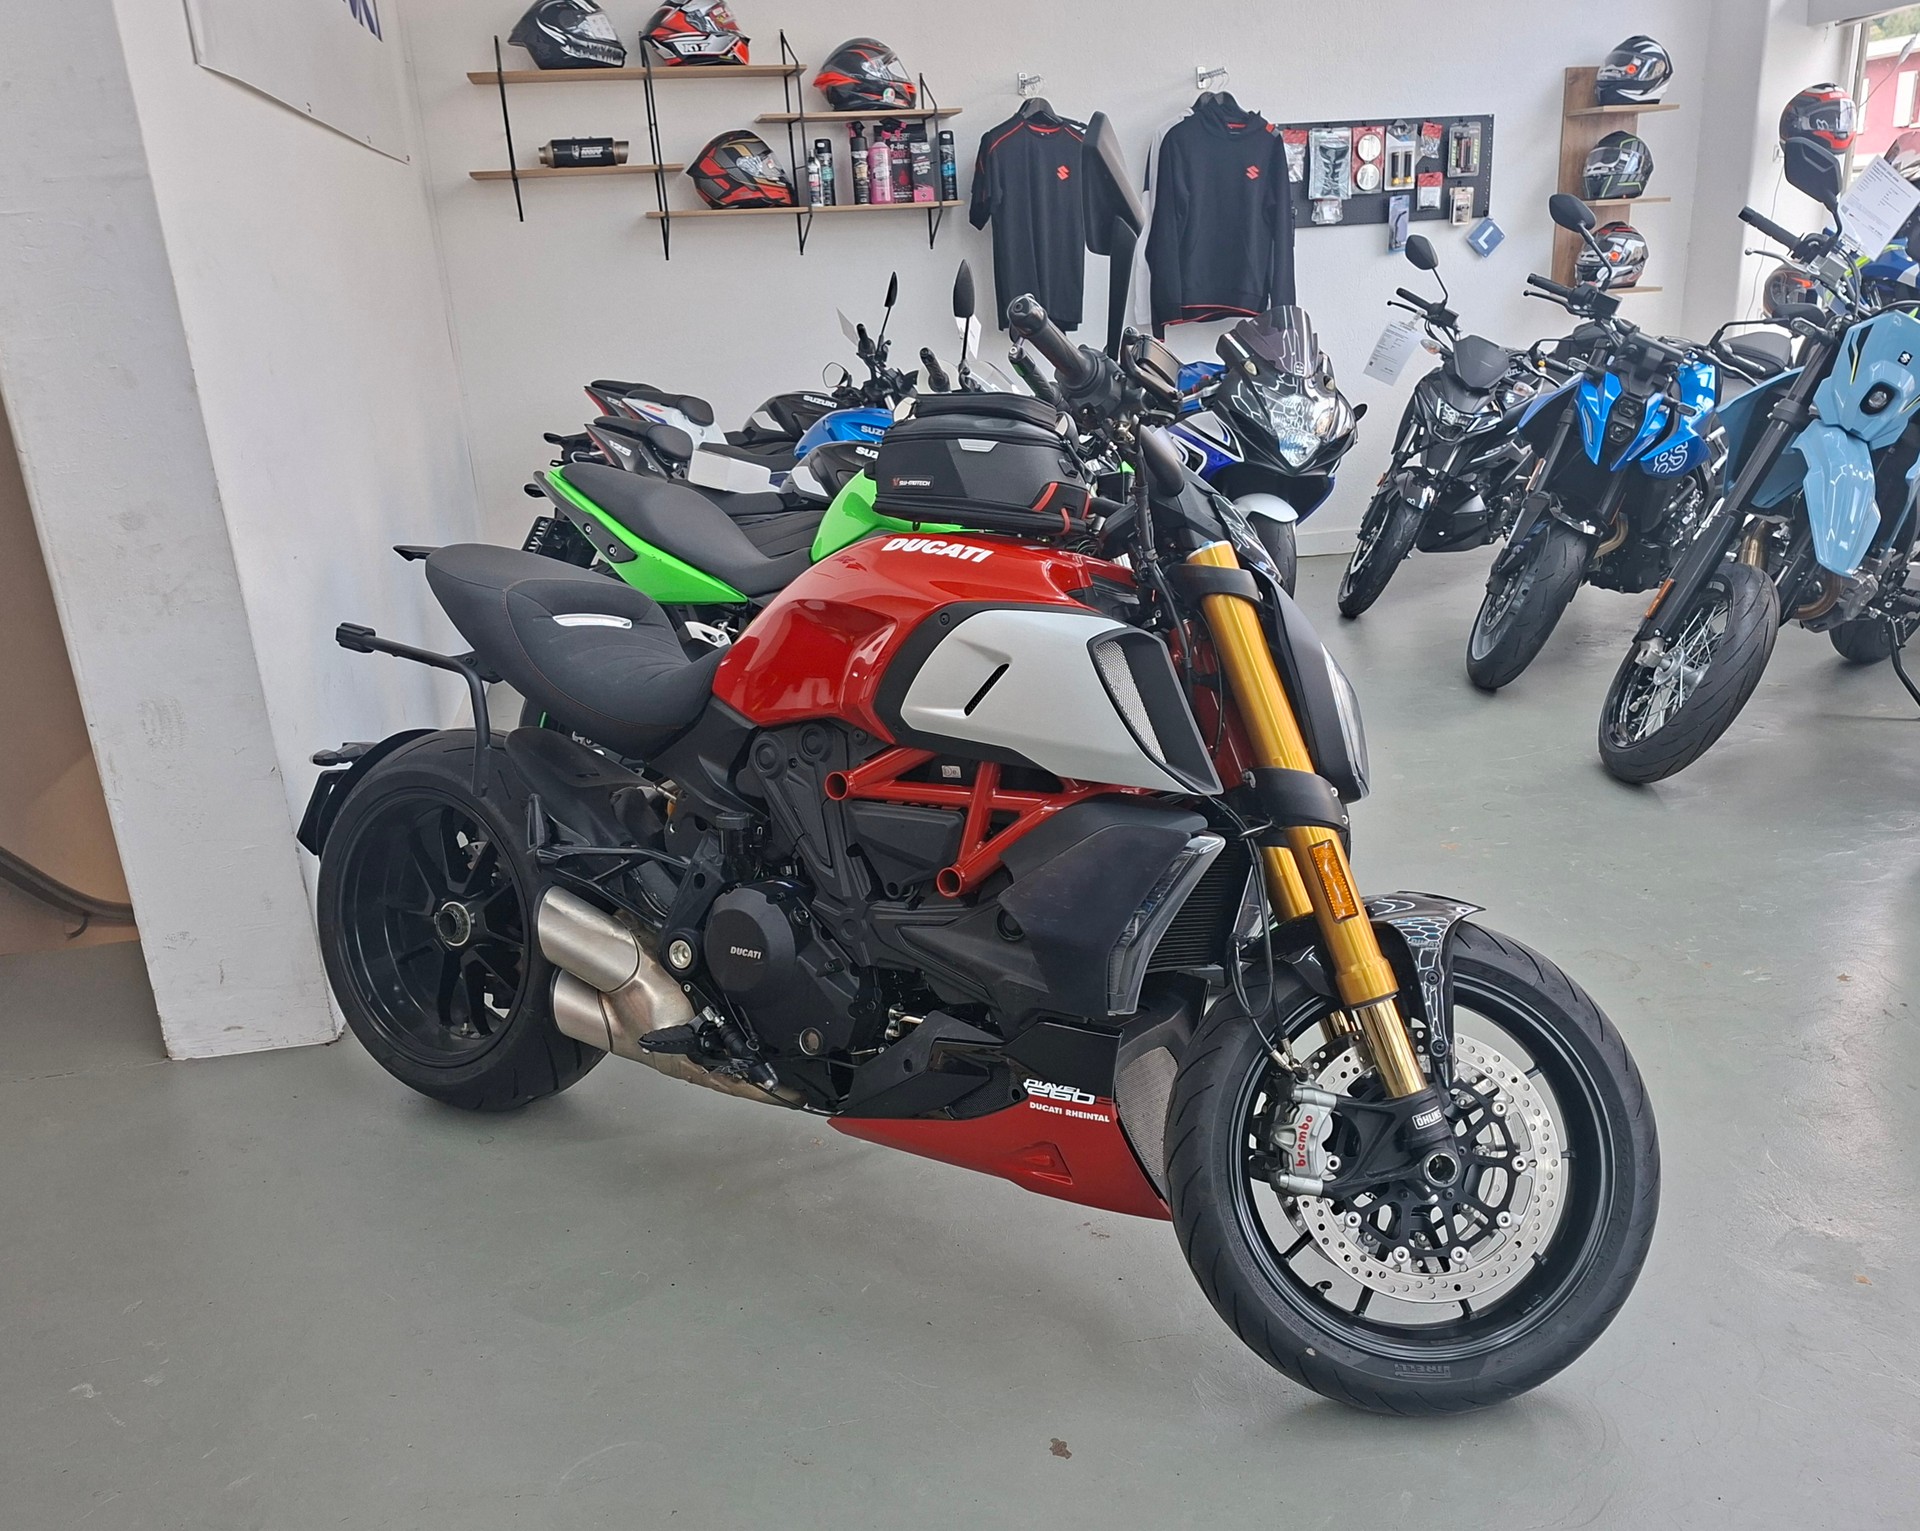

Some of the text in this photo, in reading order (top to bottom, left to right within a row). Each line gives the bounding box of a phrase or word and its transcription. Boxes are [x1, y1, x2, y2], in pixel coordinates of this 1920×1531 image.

[803, 395, 837, 408] SUZUKI
[861, 425, 885, 436] SUZ
[881, 538, 994, 563] DUCATI
[730, 946, 761, 959] DUCATI
[1029, 1101, 1110, 1122] DUCATI RHEINTAL
[1295, 1115, 1313, 1167] brembo
